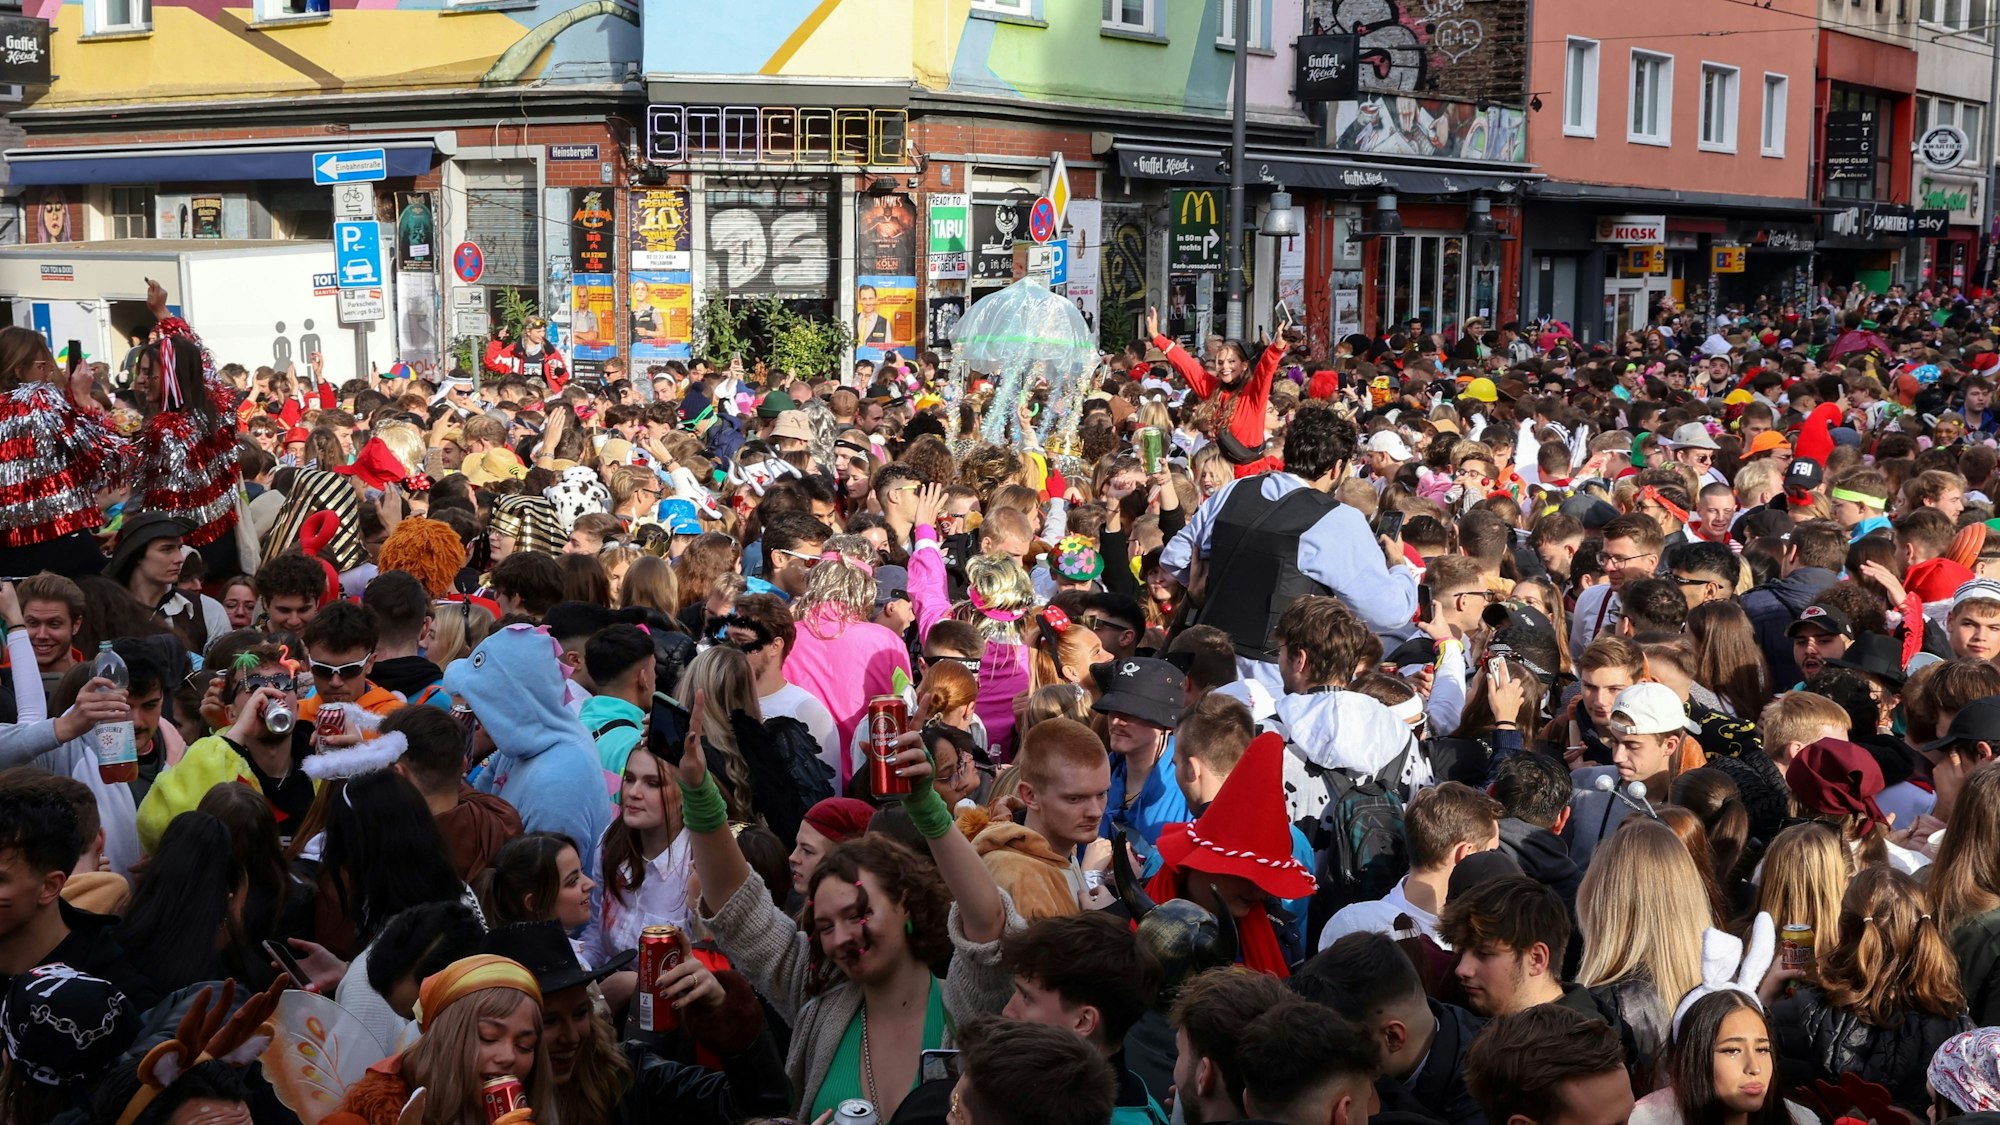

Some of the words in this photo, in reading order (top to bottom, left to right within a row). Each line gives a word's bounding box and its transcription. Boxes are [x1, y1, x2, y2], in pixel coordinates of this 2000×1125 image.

[6, 35, 38, 51] Gaffel
[5, 50, 39, 64] Kölsch
[1308, 54, 1339, 68] Gaffel
[1307, 67, 1338, 82] Kölsch
[552, 146, 594, 159] Heinsbergstr.
[1922, 143, 1963, 151] KWARTIER
[335, 160, 381, 171] Einbahnstraße
[1139, 156, 1164, 175] Gaffel
[1165, 157, 1190, 176] Kölsch
[1344, 170, 1364, 187] Gaffel
[646, 190, 676, 200] DEINE
[932, 196, 951, 206] READY
[952, 196, 961, 205] TO
[638, 198, 685, 208] FREUNDE
[639, 207, 683, 232] 10
[1918, 216, 1944, 231] sky
[933, 219, 964, 239] TABU
[1615, 227, 1657, 240] KIOSK
[342, 226, 362, 252] P
[1179, 243, 1201, 251] rechts
[930, 253, 966, 263] SCHAUSPIEL
[314, 276, 331, 286] TOI
[1792, 462, 1813, 476] FBI
